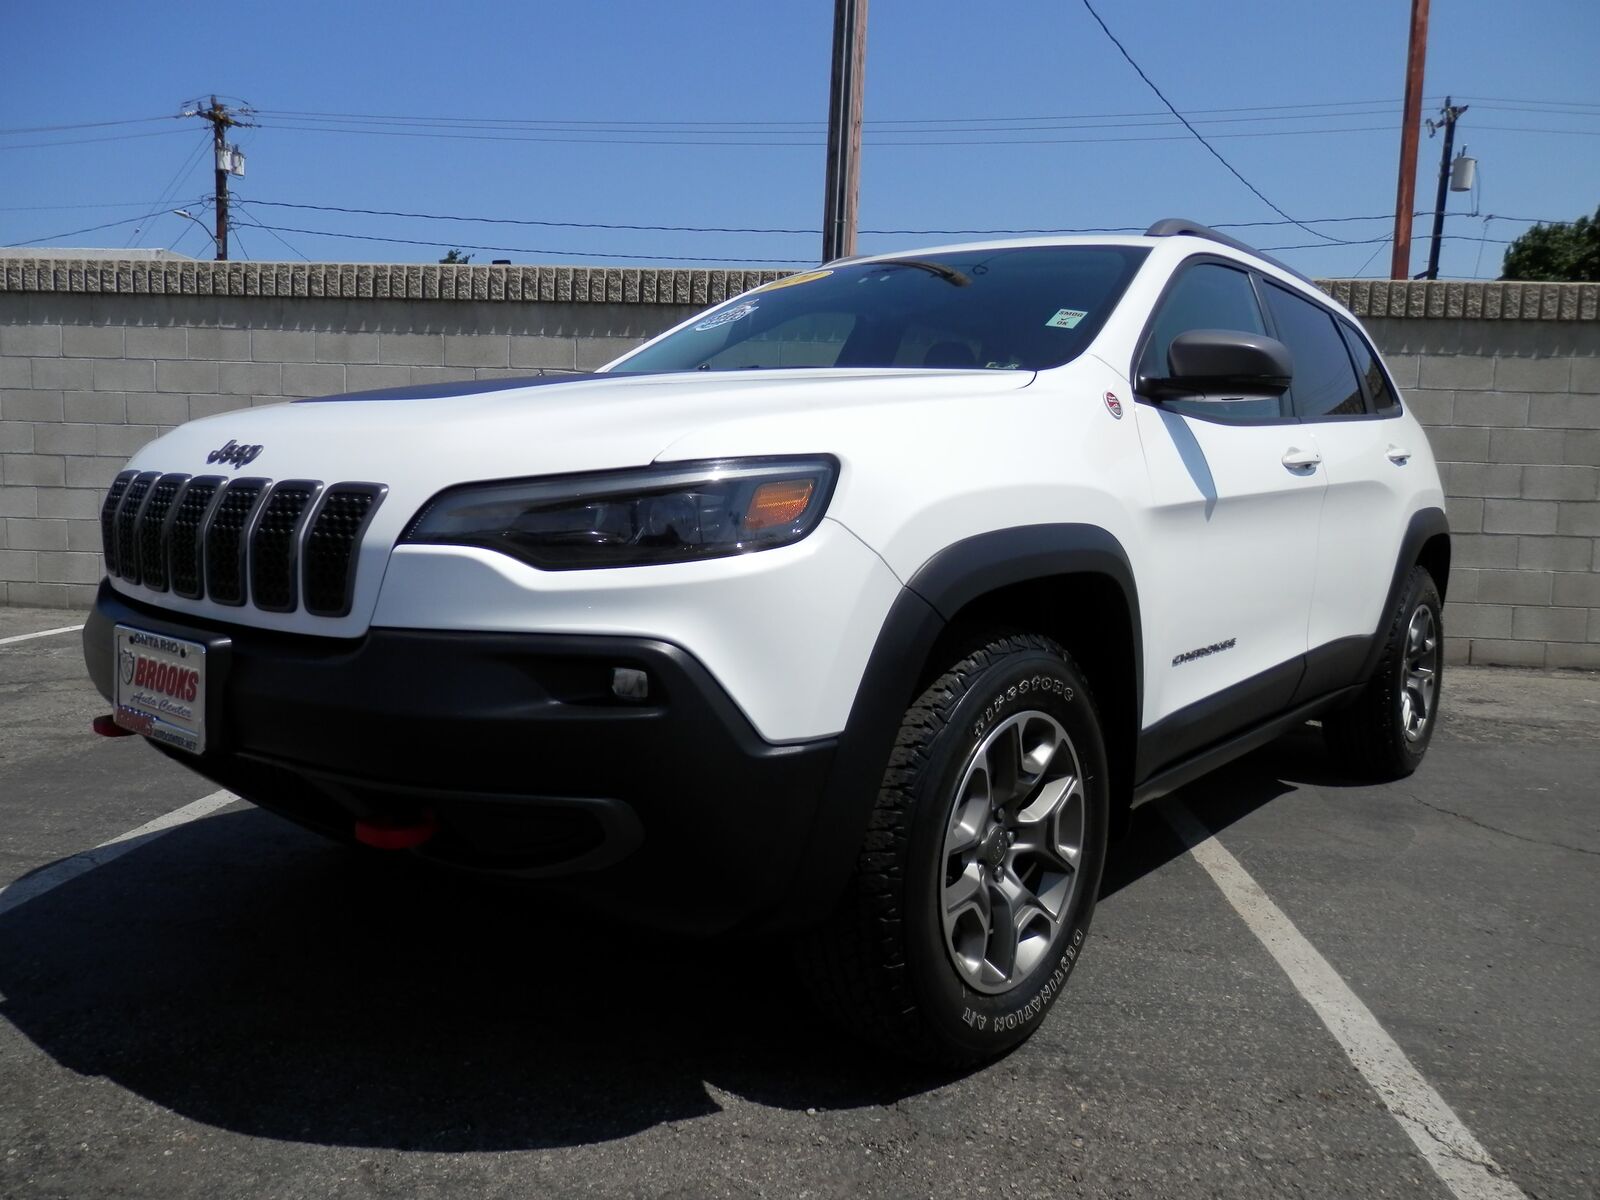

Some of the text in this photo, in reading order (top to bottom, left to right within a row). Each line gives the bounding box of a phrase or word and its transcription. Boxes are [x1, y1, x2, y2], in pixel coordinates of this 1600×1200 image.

[1059, 310, 1084, 318] SMOG
[206, 439, 264, 470] Jeep
[134, 633, 178, 653] ONTARIO
[135, 656, 199, 702] BROOKS
[130, 691, 156, 706] Auto
[993, 928, 1083, 1033] DESTINATION
